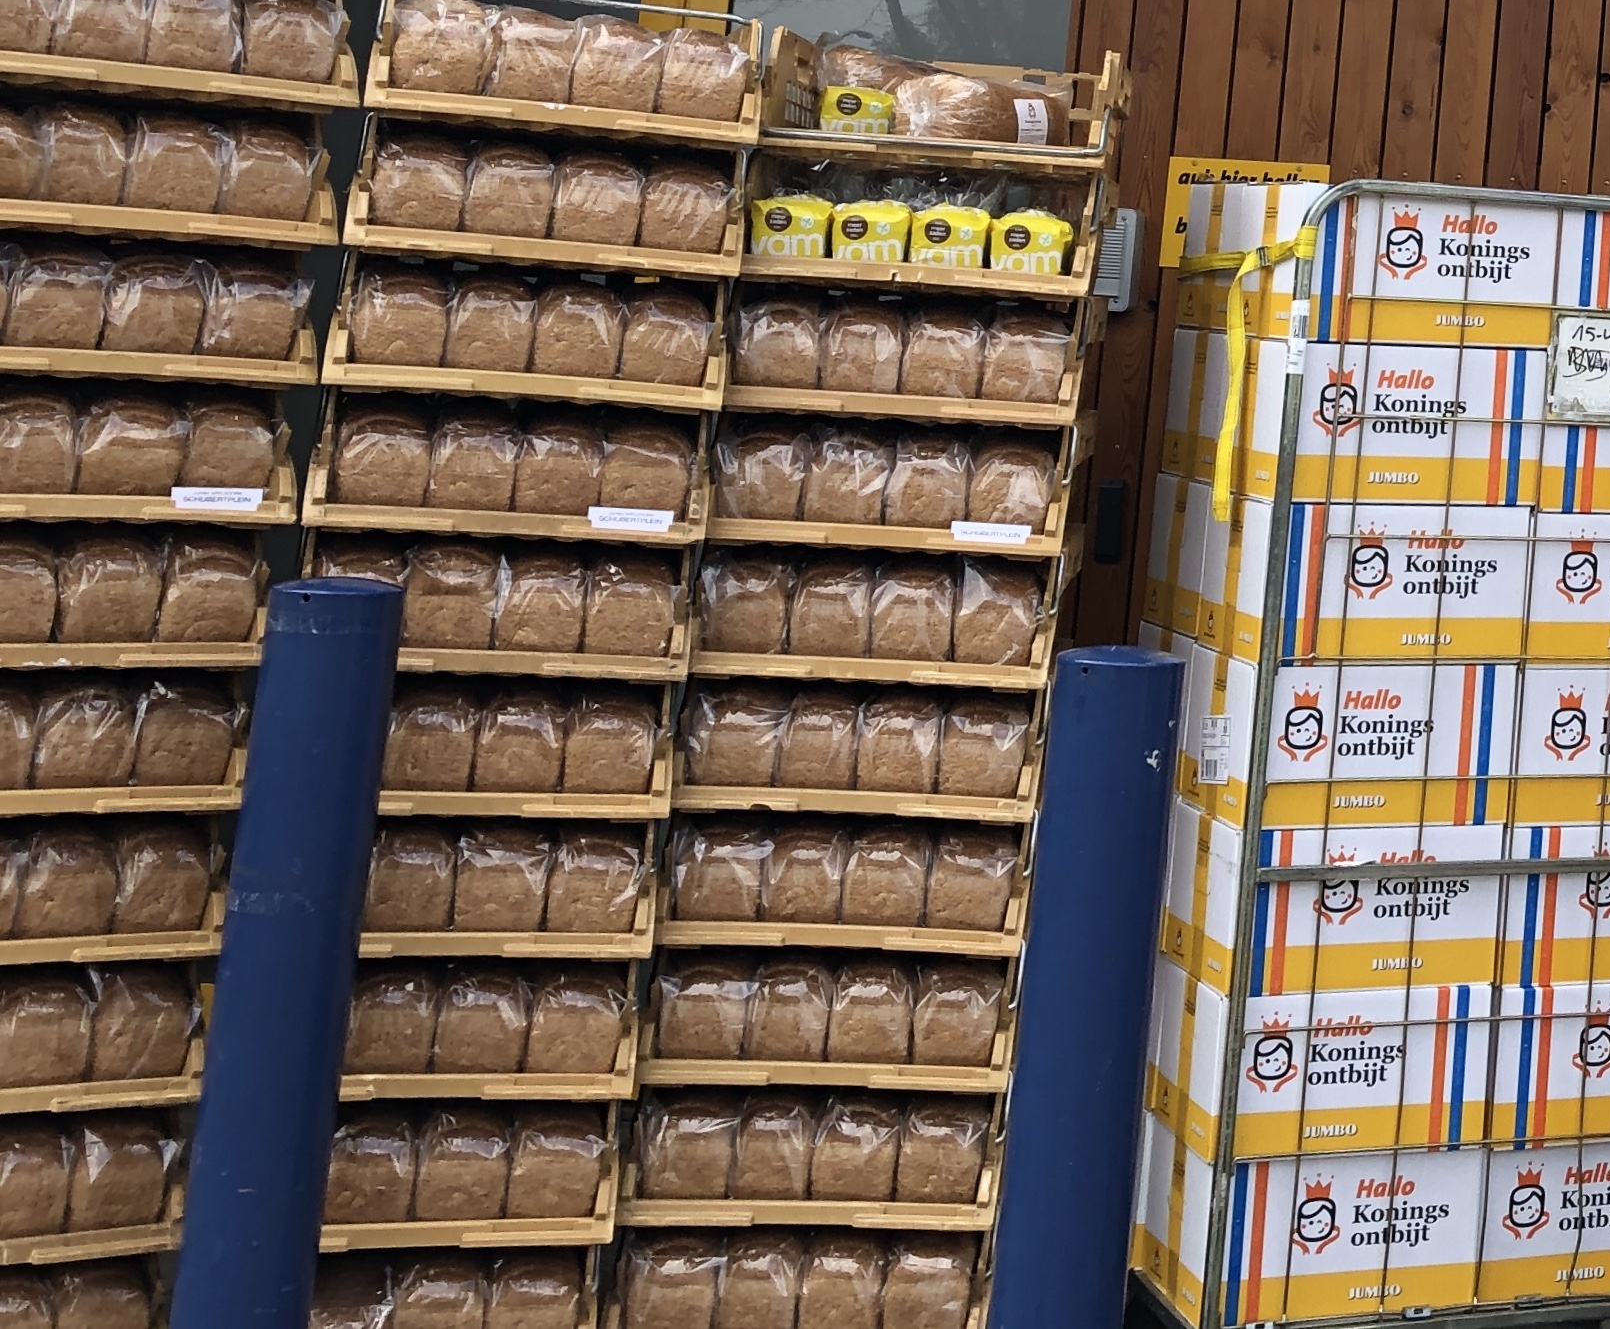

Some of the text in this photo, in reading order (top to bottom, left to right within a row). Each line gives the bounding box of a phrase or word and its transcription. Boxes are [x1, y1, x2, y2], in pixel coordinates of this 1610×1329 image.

[1442, 215, 1498, 235] Hallo
[1438, 238, 1530, 263] Konings
[1438, 260, 1512, 283] ontbijt
[1435, 314, 1485, 327] JUMBO
[1377, 370, 1435, 389] Hallo
[1373, 394, 1466, 417] Konings
[1372, 420, 1448, 439] ontbijt
[1367, 472, 1420, 484] JUMBO
[1408, 529, 1465, 549] Hallo
[1404, 554, 1497, 578] Konings
[1403, 575, 1479, 599] ontbijt
[1343, 689, 1401, 710] Hallo
[1338, 714, 1434, 738] Konings
[1338, 736, 1415, 760] ontbijt
[1333, 795, 1385, 808] JUMBO
[1374, 877, 1470, 898] Konings
[1373, 897, 1451, 920] ontbijt
[1371, 957, 1423, 970] JUMBO
[1313, 1015, 1373, 1038] Hallo
[1309, 1041, 1406, 1064] Konings
[1308, 1063, 1388, 1087] ontbijt
[1303, 1124, 1358, 1139] JUMBO
[1352, 1201, 1449, 1224] Konings
[1351, 1222, 1430, 1247] ontbijt
[1554, 1266, 1605, 1282] JUMBO
[1348, 1284, 1401, 1300] JUMBO
